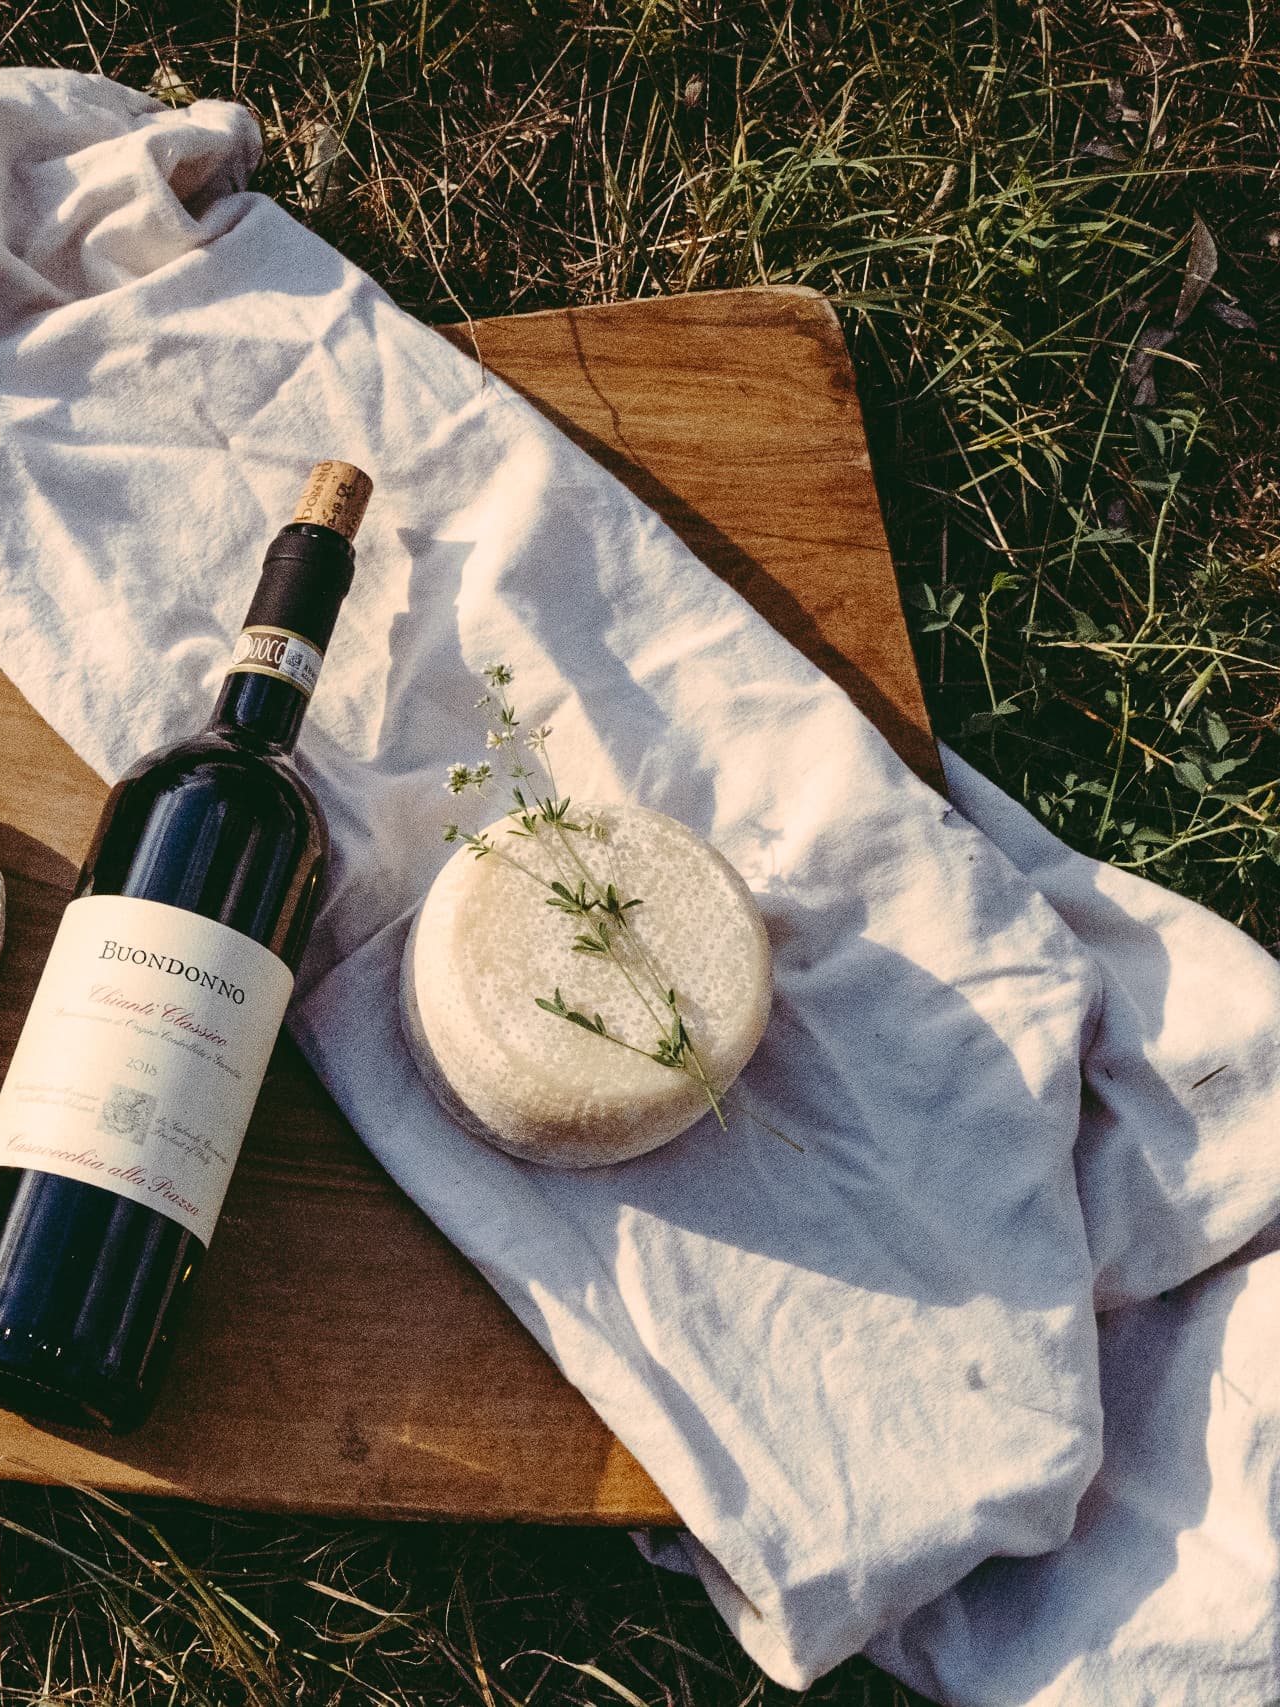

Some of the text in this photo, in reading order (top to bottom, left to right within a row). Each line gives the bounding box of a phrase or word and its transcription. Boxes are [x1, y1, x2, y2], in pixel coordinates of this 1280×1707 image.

[98, 940, 245, 1005] BUONDONNO
[88, 984, 160, 1016] Chianti
[161, 1003, 228, 1046] Classico
[6, 1134, 200, 1218] Casavecchia alla Piazza
